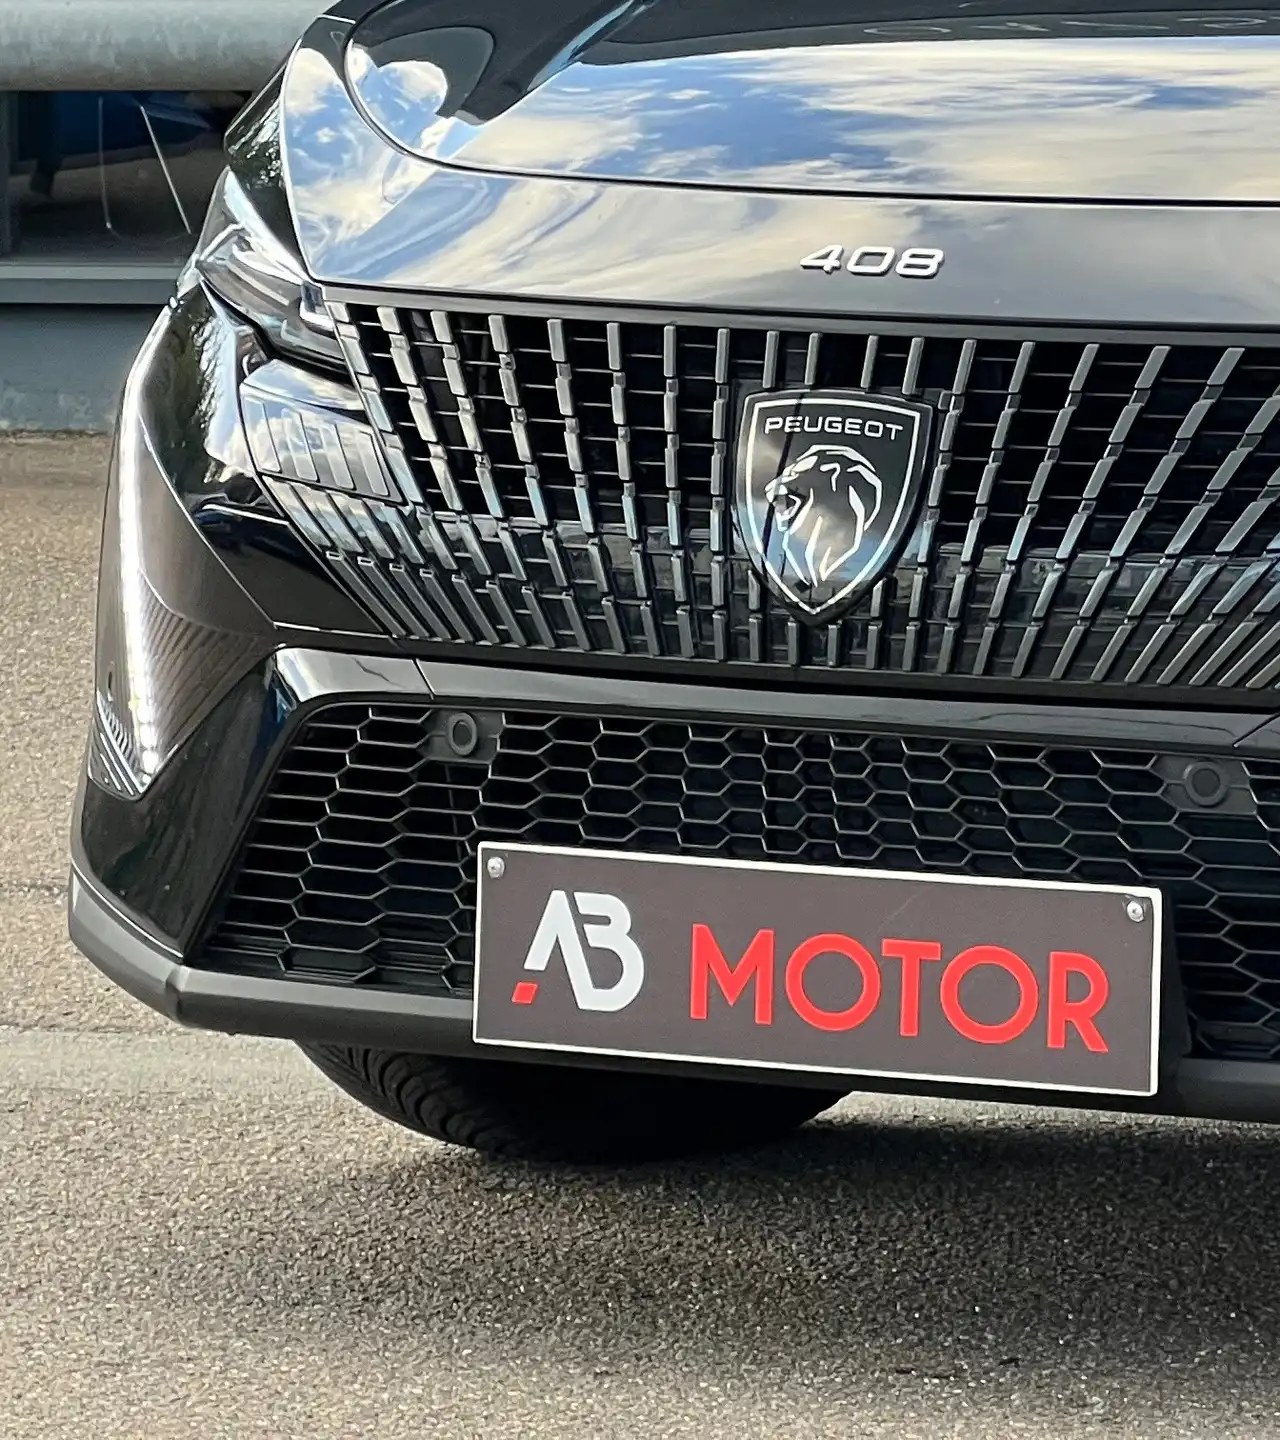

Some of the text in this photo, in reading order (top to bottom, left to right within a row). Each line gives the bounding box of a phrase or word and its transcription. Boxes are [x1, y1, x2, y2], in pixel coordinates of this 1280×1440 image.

[800, 244, 944, 279] 408
[764, 415, 904, 441] PEUGEOT
[690, 923, 1110, 1053] MOTOR
